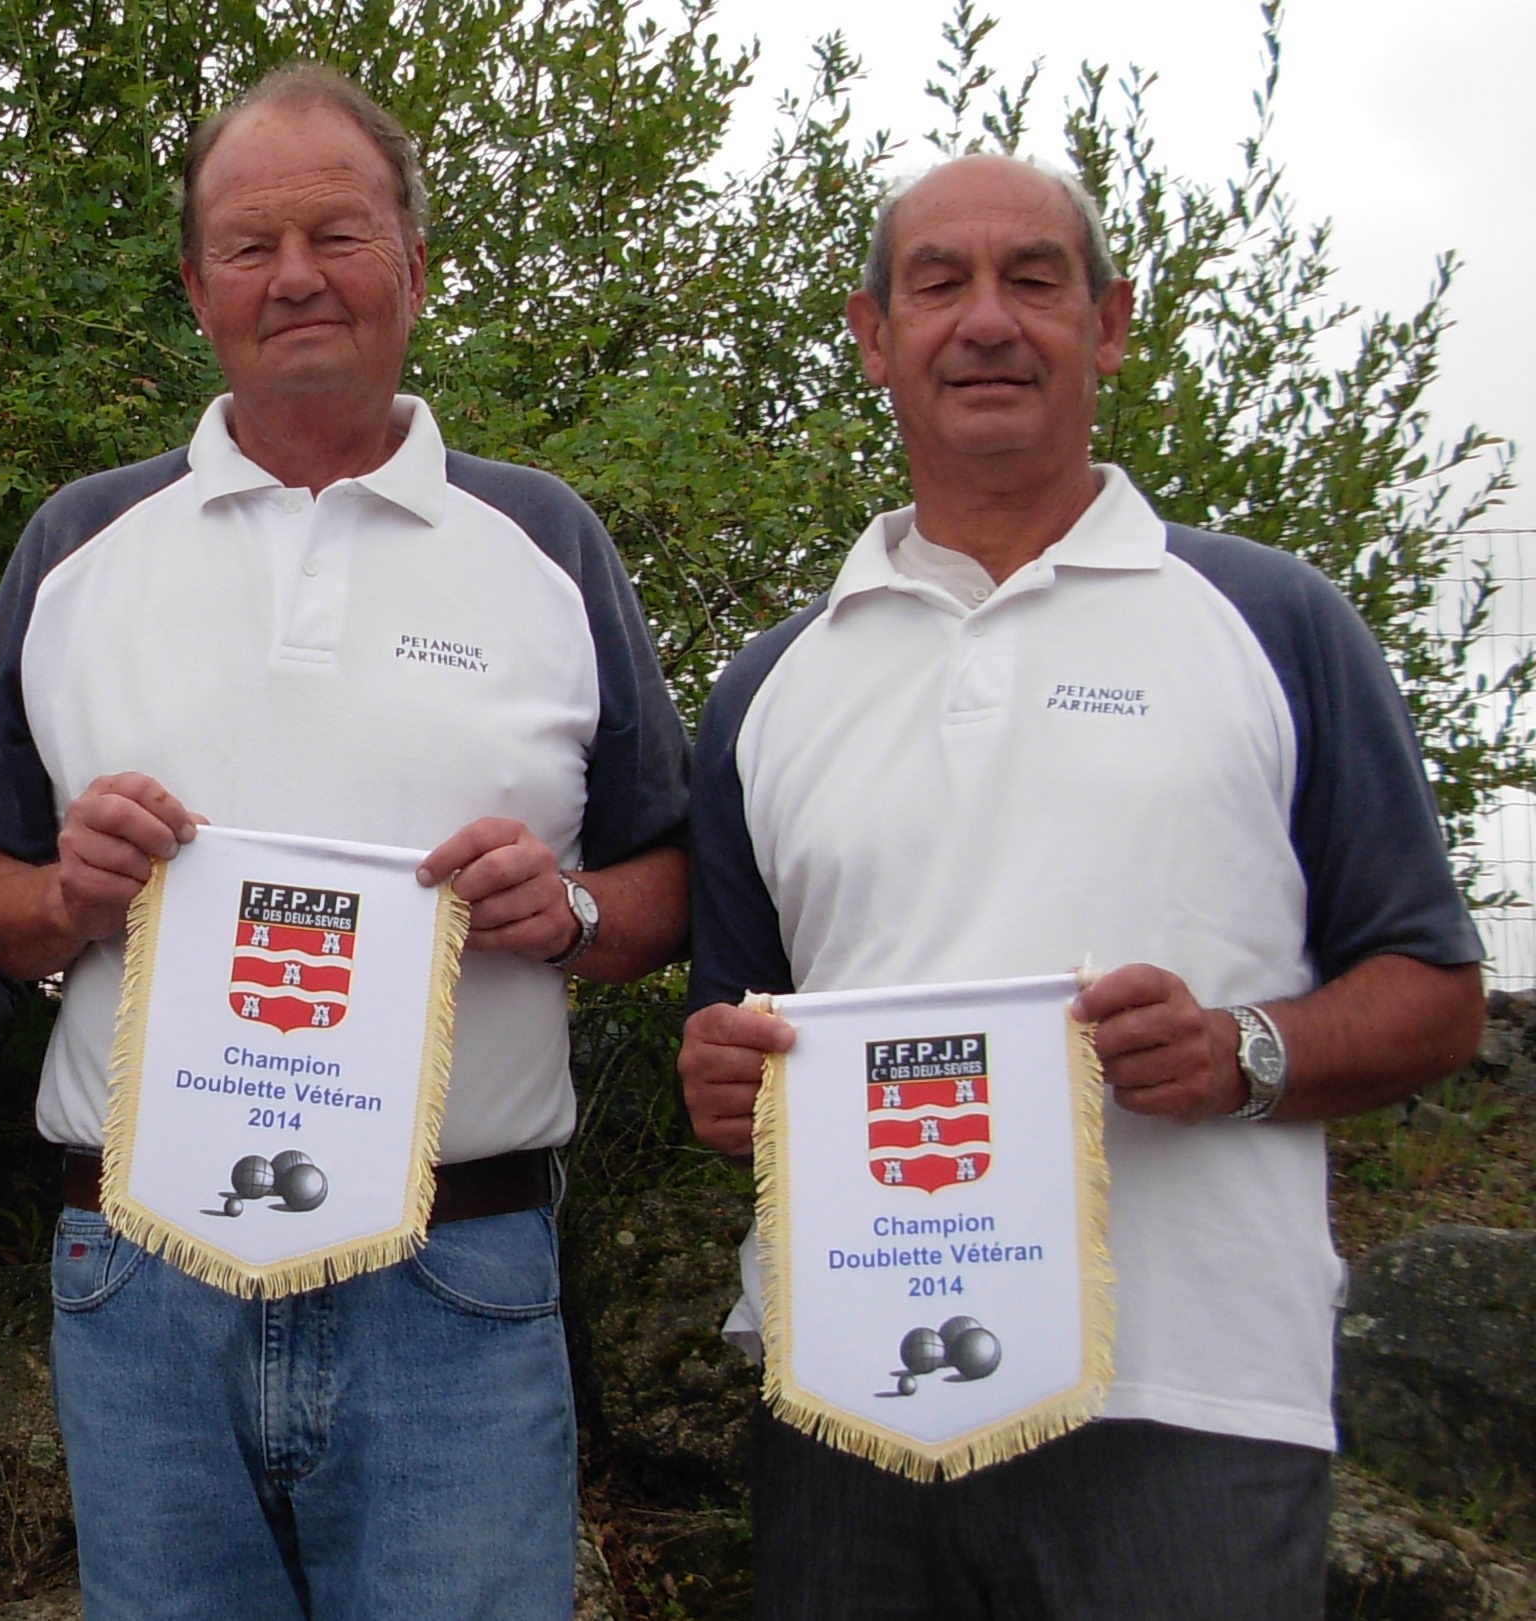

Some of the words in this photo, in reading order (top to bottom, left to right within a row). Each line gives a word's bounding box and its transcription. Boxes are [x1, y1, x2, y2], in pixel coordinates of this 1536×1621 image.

[394, 647, 489, 673] PARTHENAY
[1046, 697, 1150, 716] PARTHENAY
[263, 909, 282, 923] DES
[284, 912, 352, 930] DEUX-SEVRES
[223, 1046, 341, 1078] Champion
[890, 1065, 911, 1079] DES
[913, 1060, 983, 1077] DEUX-SEVRES
[175, 1069, 287, 1101] Doublette
[294, 1083, 382, 1112] Vétéran
[247, 1107, 303, 1132] 2014
[873, 1213, 996, 1239] Champion
[828, 1247, 943, 1270] Doublette
[949, 1242, 1044, 1265] Vétéran
[908, 1275, 965, 1298] 2014
